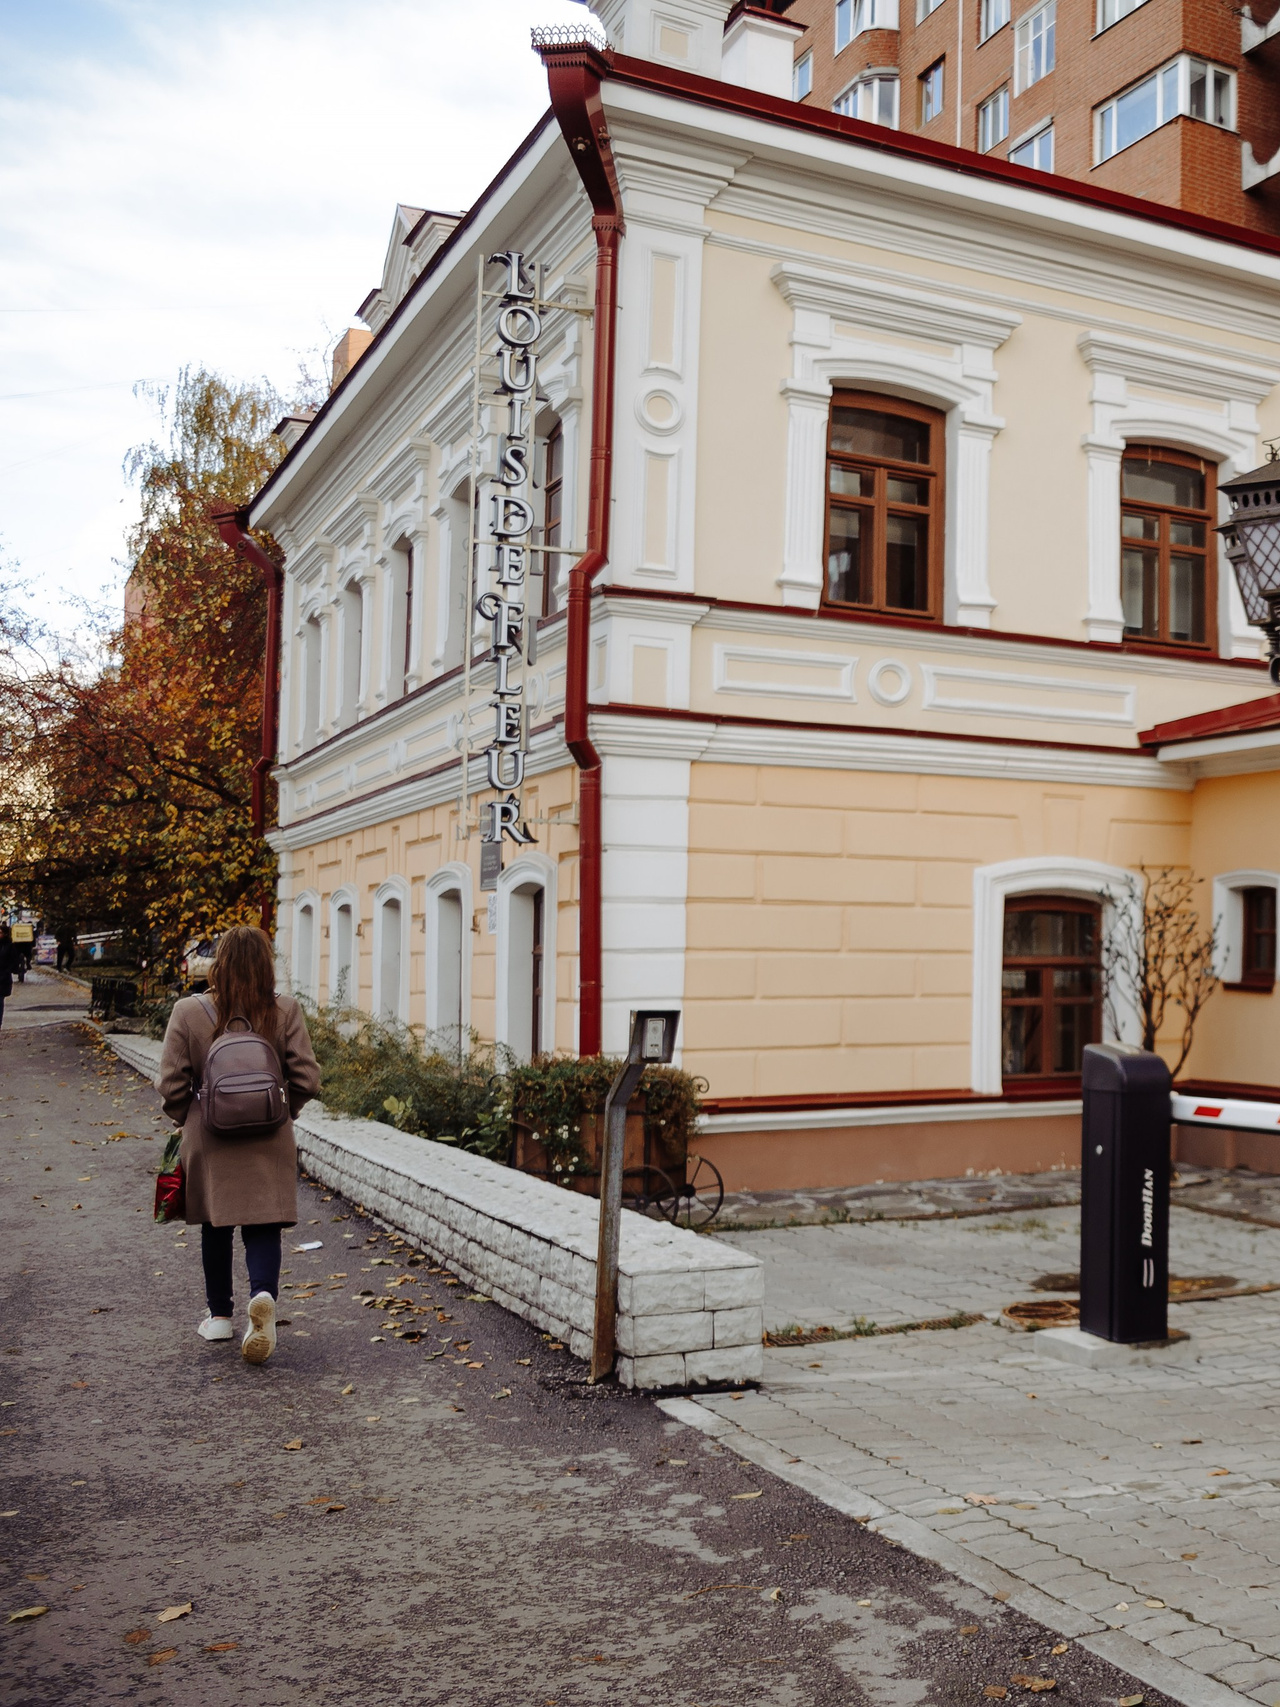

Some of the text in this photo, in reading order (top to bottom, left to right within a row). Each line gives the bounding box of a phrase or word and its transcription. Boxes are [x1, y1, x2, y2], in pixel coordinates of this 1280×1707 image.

[486, 251, 541, 843] LOUIS DE FLEUR
